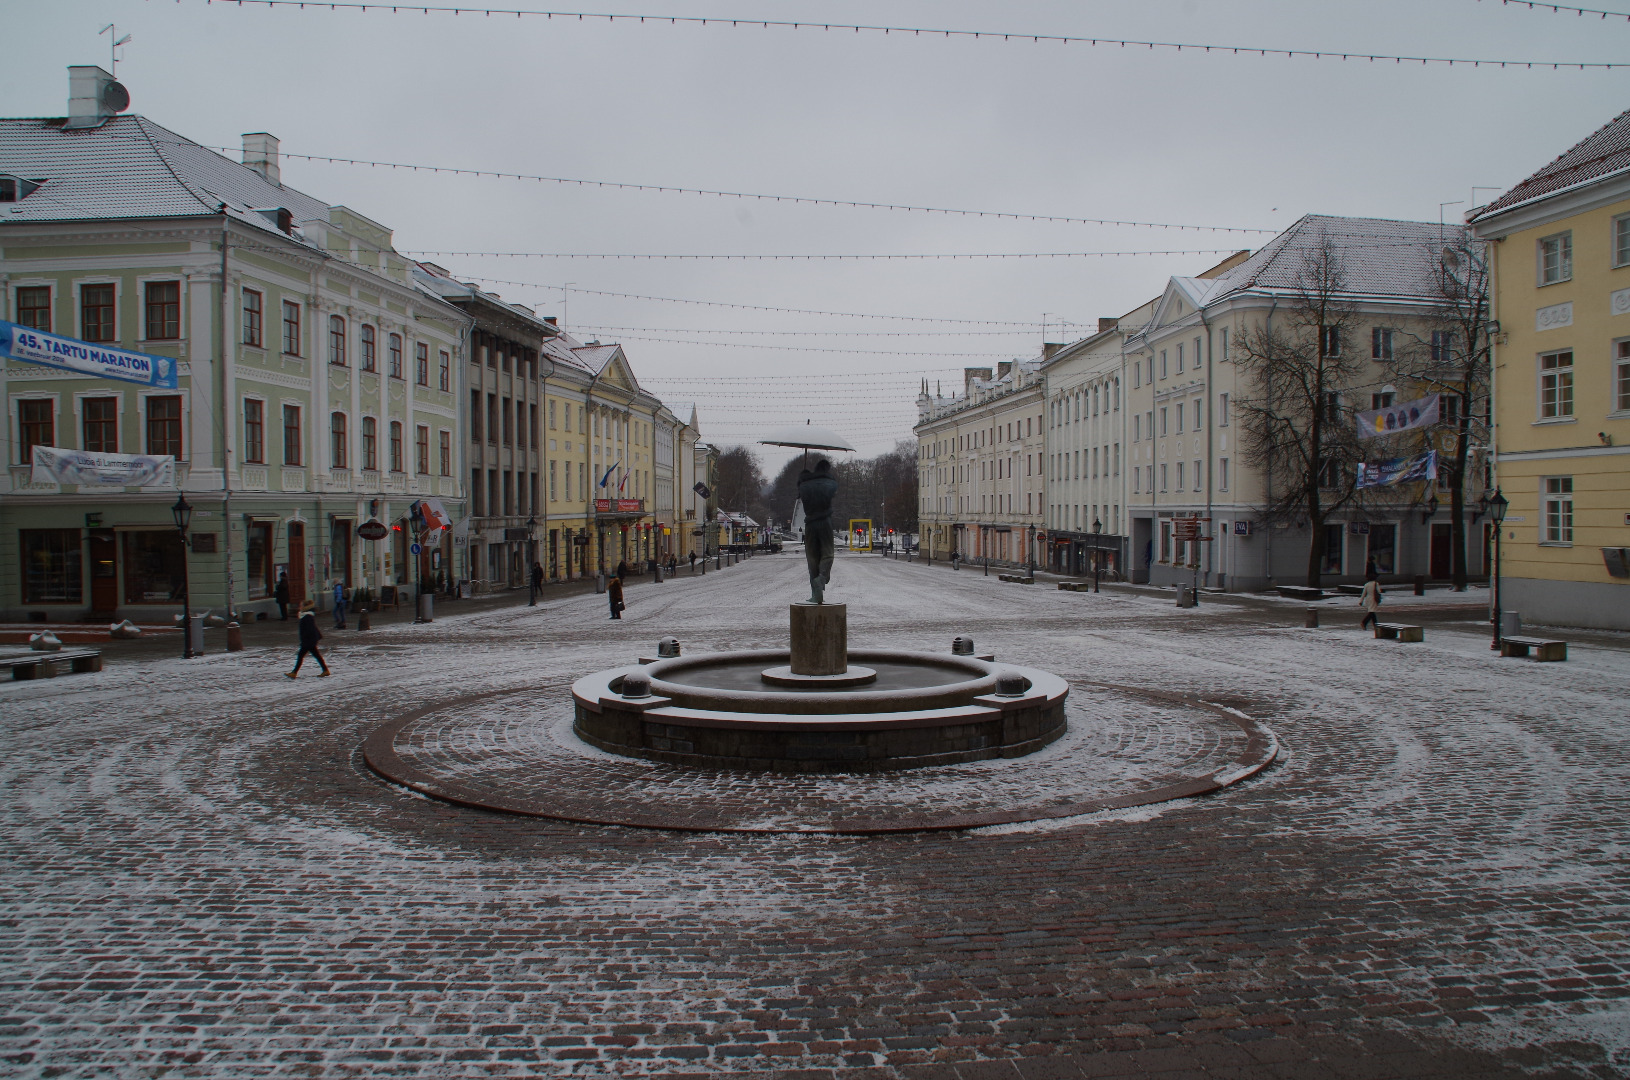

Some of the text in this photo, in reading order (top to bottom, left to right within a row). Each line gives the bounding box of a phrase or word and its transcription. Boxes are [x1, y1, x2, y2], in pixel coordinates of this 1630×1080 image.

[18, 333, 149, 372] 45. TARTU MARATON
[1235, 522, 1246, 531] EVA
